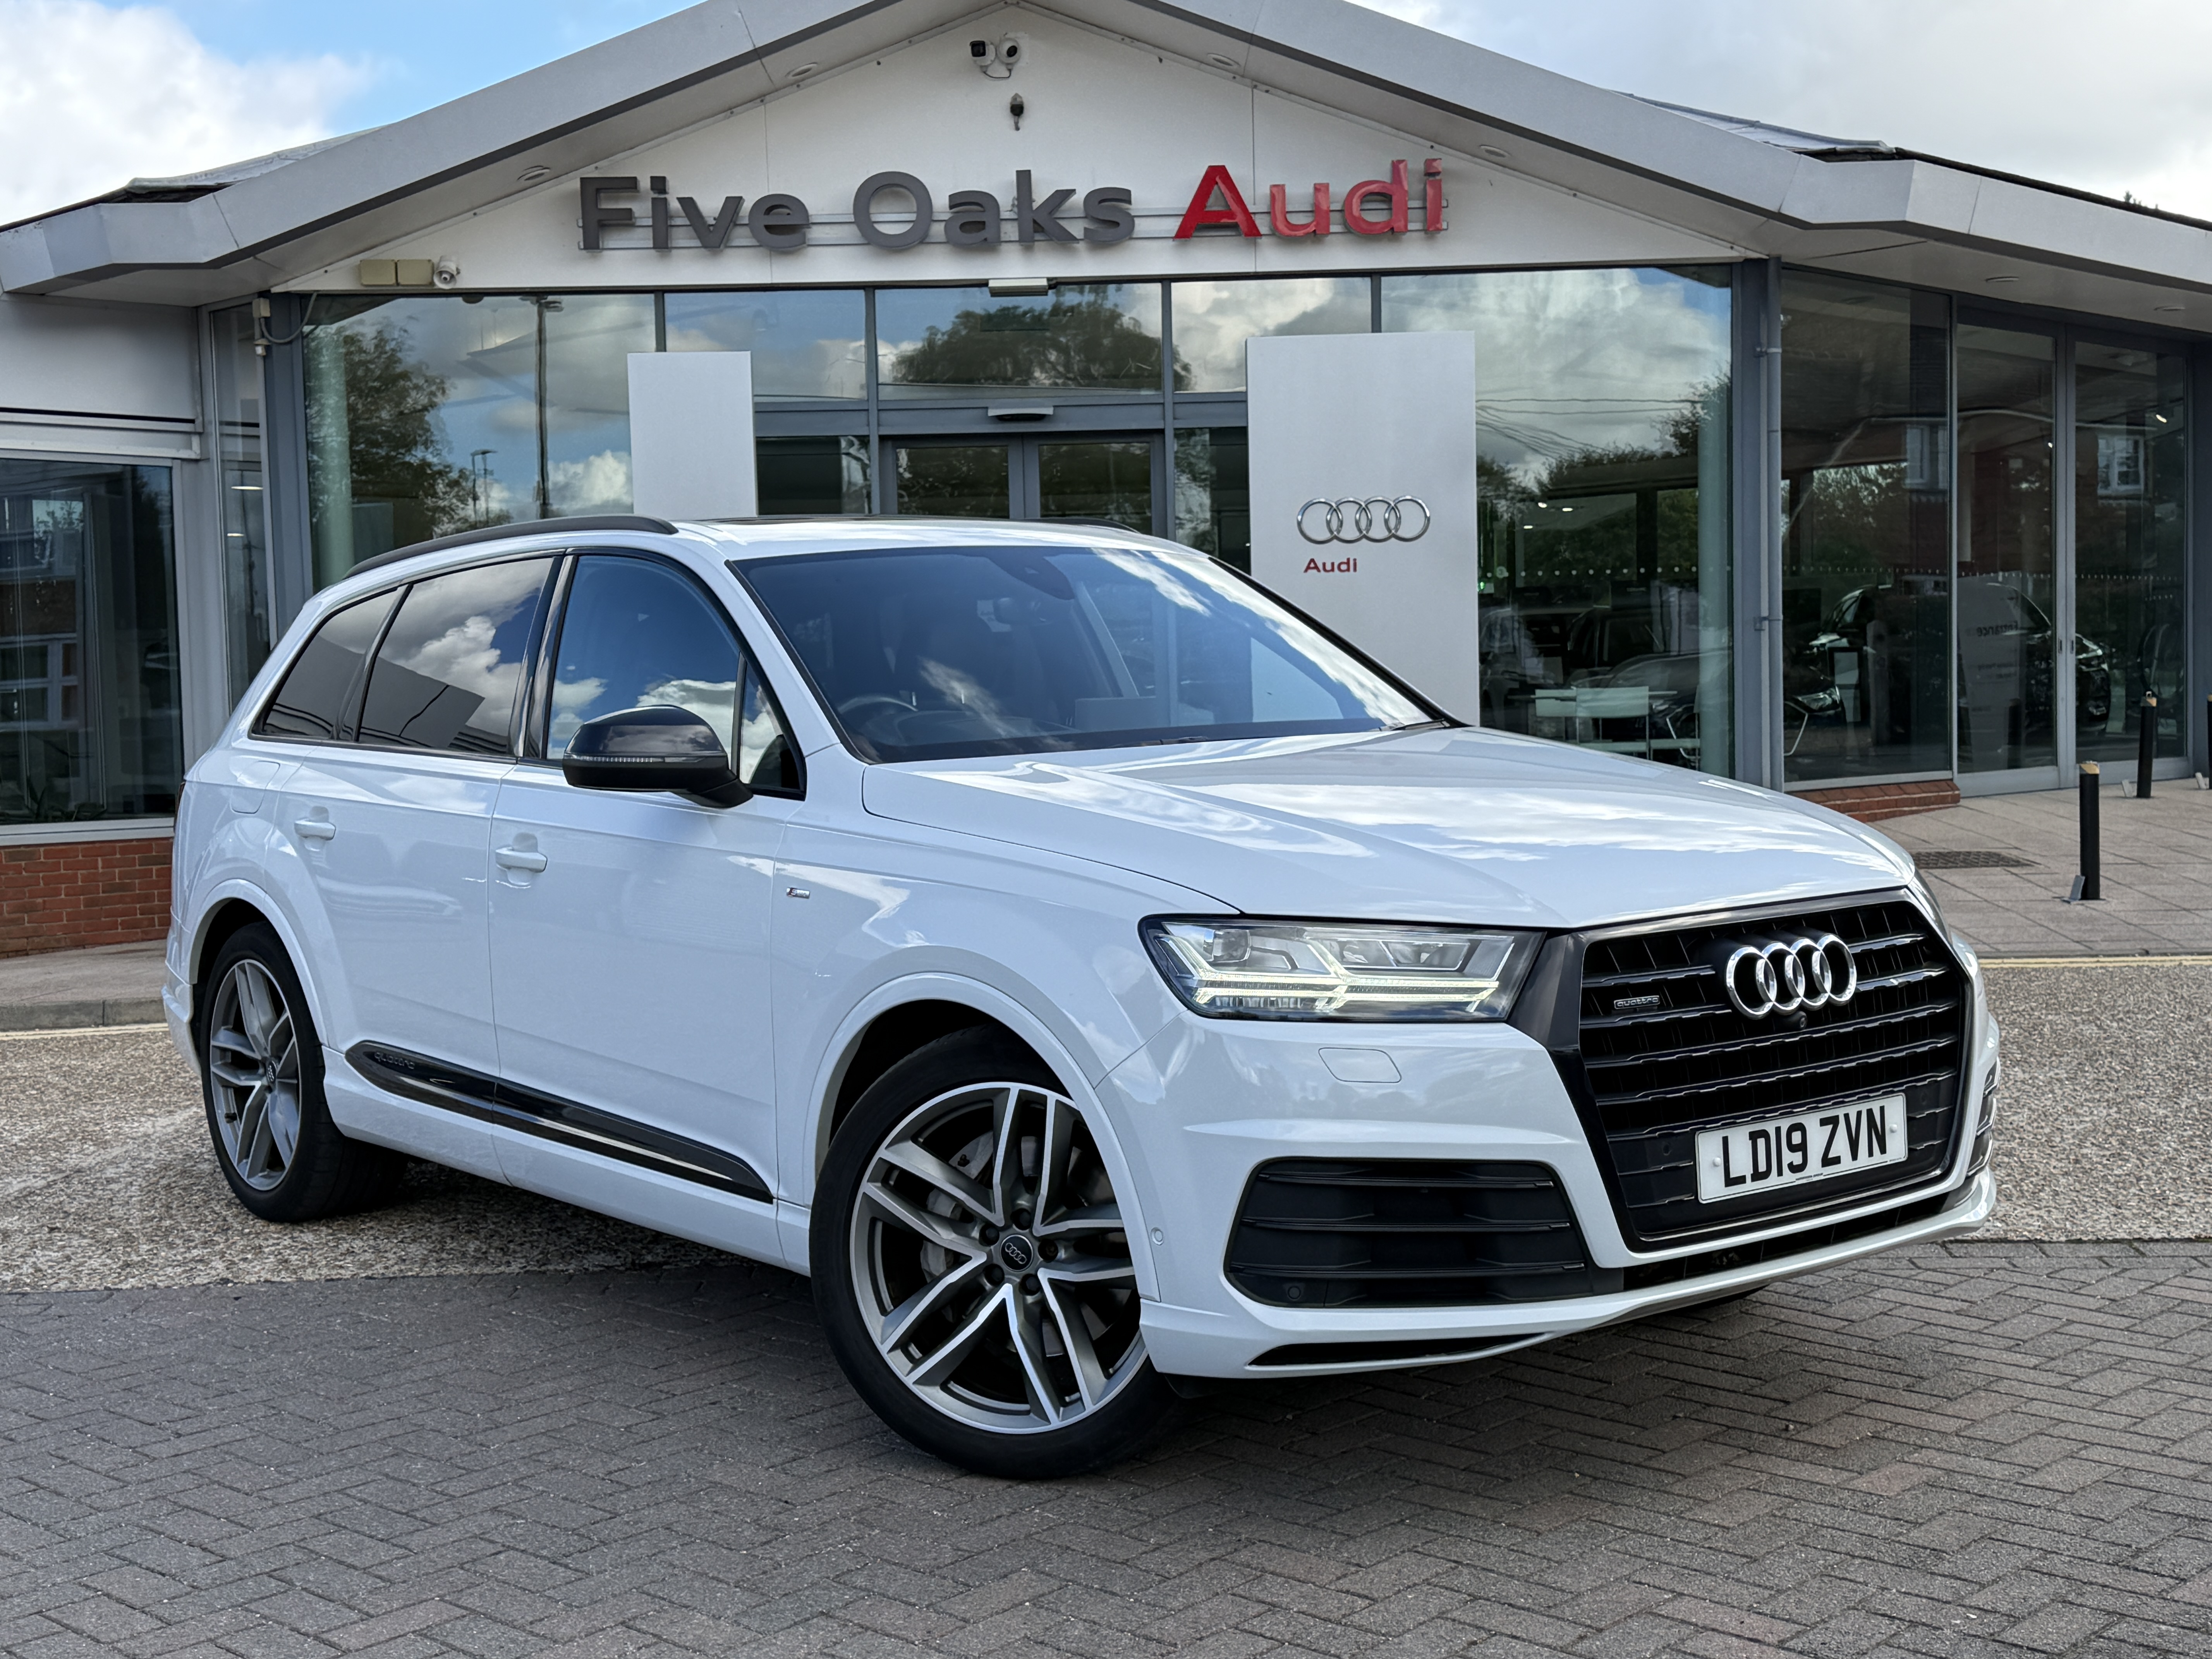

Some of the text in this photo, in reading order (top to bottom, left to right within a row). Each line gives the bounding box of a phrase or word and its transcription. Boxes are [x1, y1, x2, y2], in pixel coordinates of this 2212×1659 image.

[580, 158, 1443, 251] Five Oaks Audi
[1303, 557, 1357, 573] Audi
[1616, 997, 1659, 1008] quattro
[1722, 1105, 1887, 1188] LD19 ZVN
